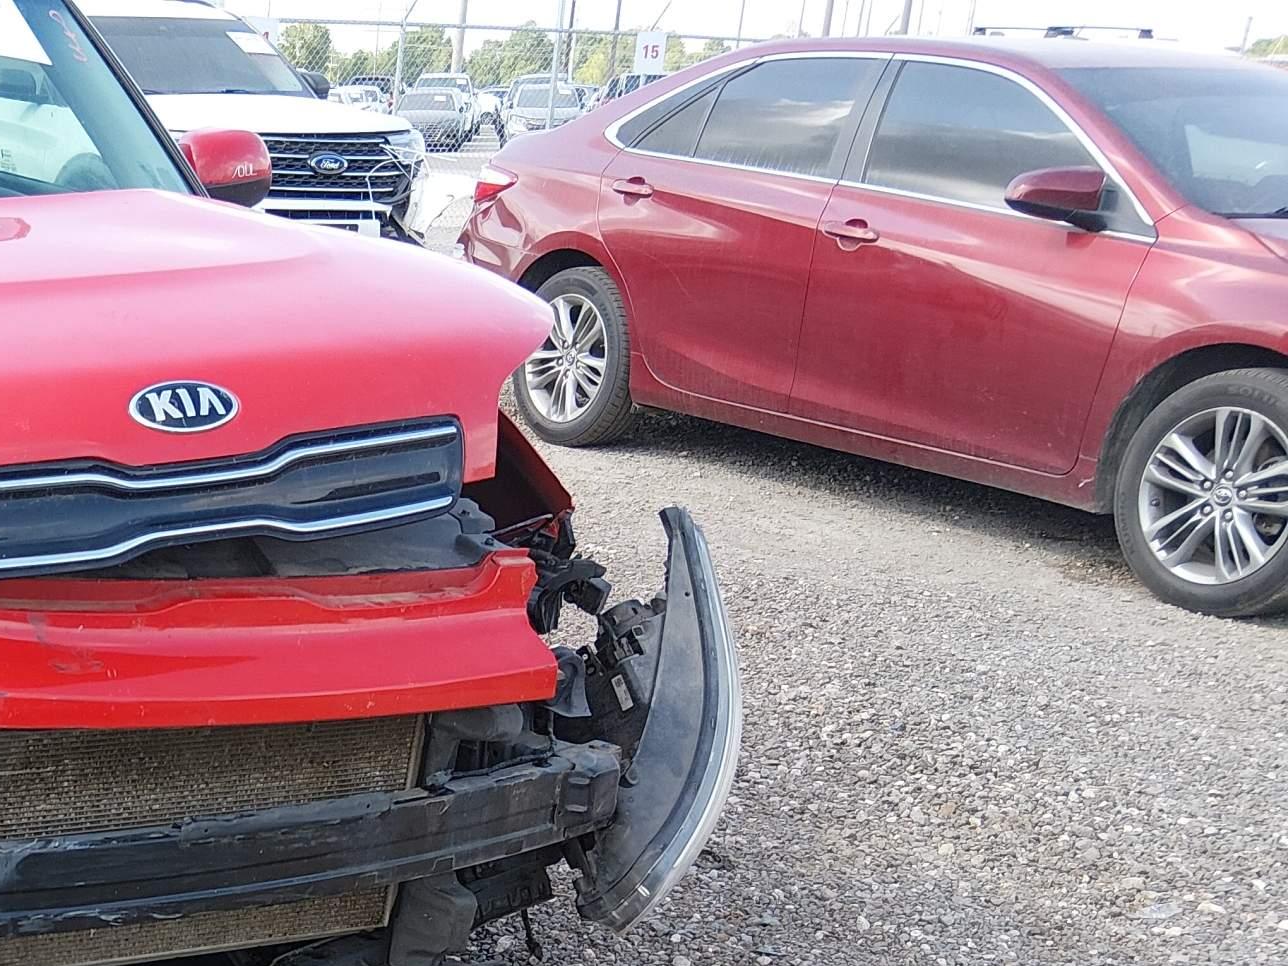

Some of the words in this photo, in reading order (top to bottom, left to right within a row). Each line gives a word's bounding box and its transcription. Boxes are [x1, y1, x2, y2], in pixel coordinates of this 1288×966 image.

[642, 44, 660, 59] 15
[320, 157, 341, 170] Ford
[144, 386, 227, 423] KIA
